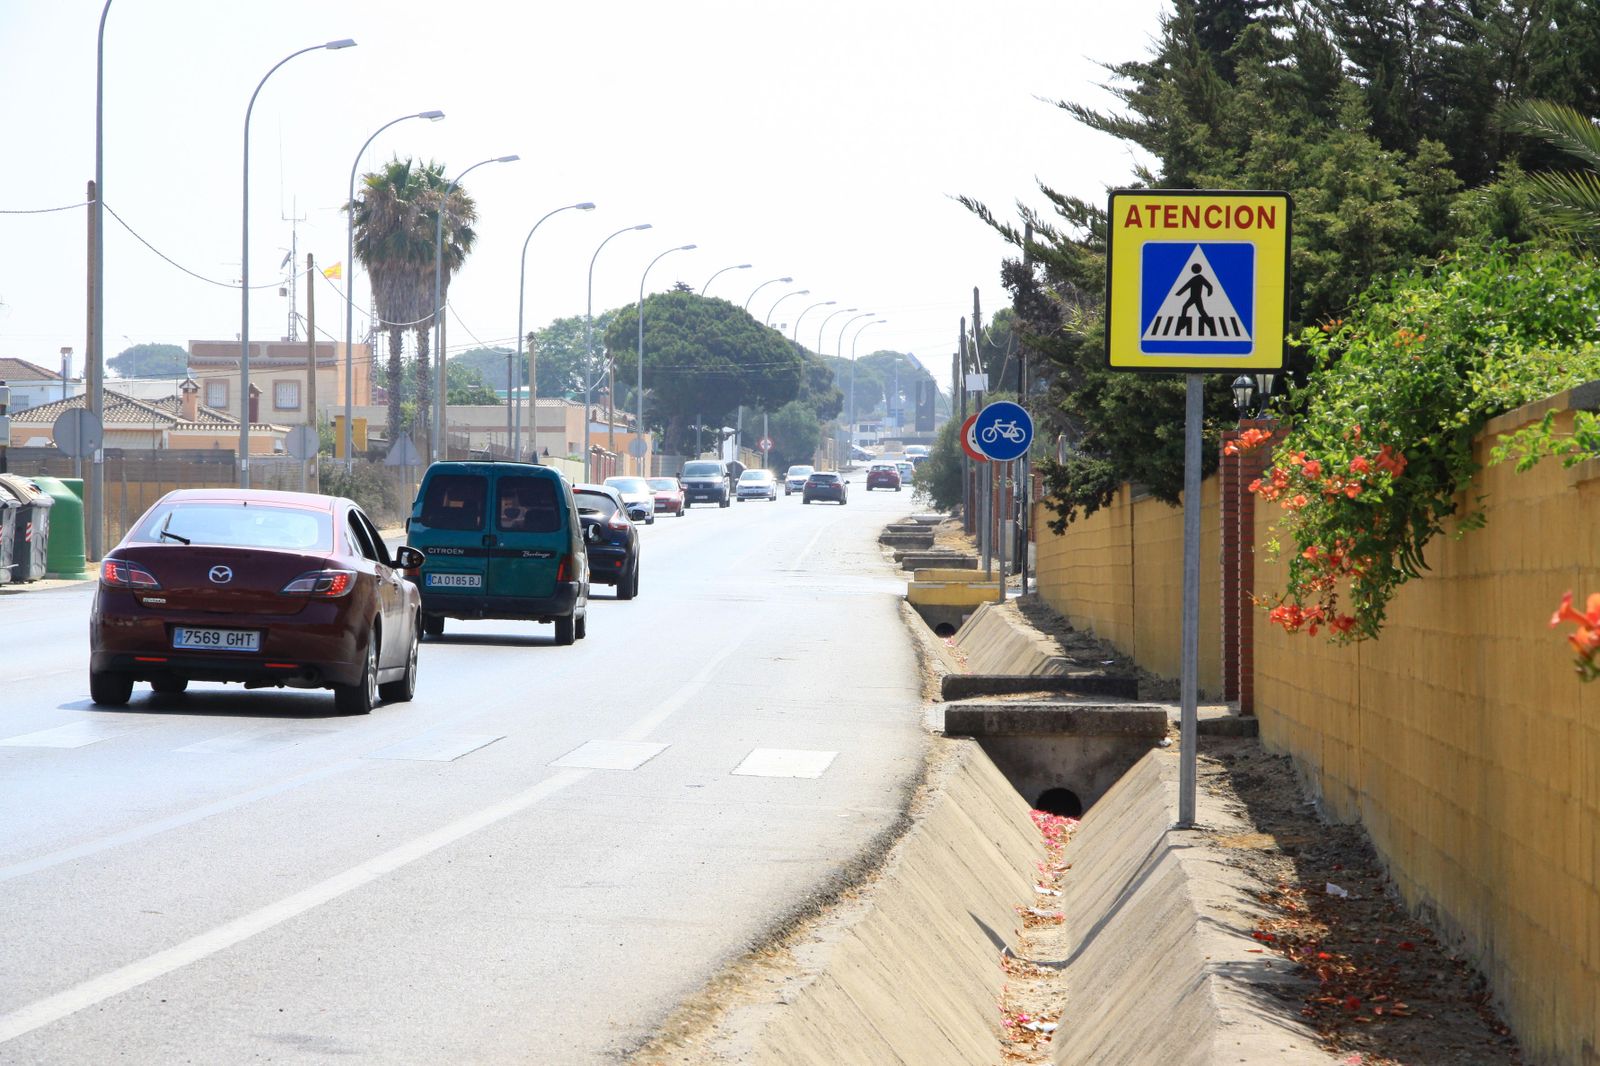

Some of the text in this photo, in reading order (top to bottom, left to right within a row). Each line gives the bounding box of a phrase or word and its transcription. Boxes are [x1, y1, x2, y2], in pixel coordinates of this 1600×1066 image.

[1124, 204, 1276, 230] ATENCION
[428, 547, 464, 555] CITROEN
[431, 575, 480, 586] CA 0185 BJ
[184, 630, 253, 646] 7569 GHT
